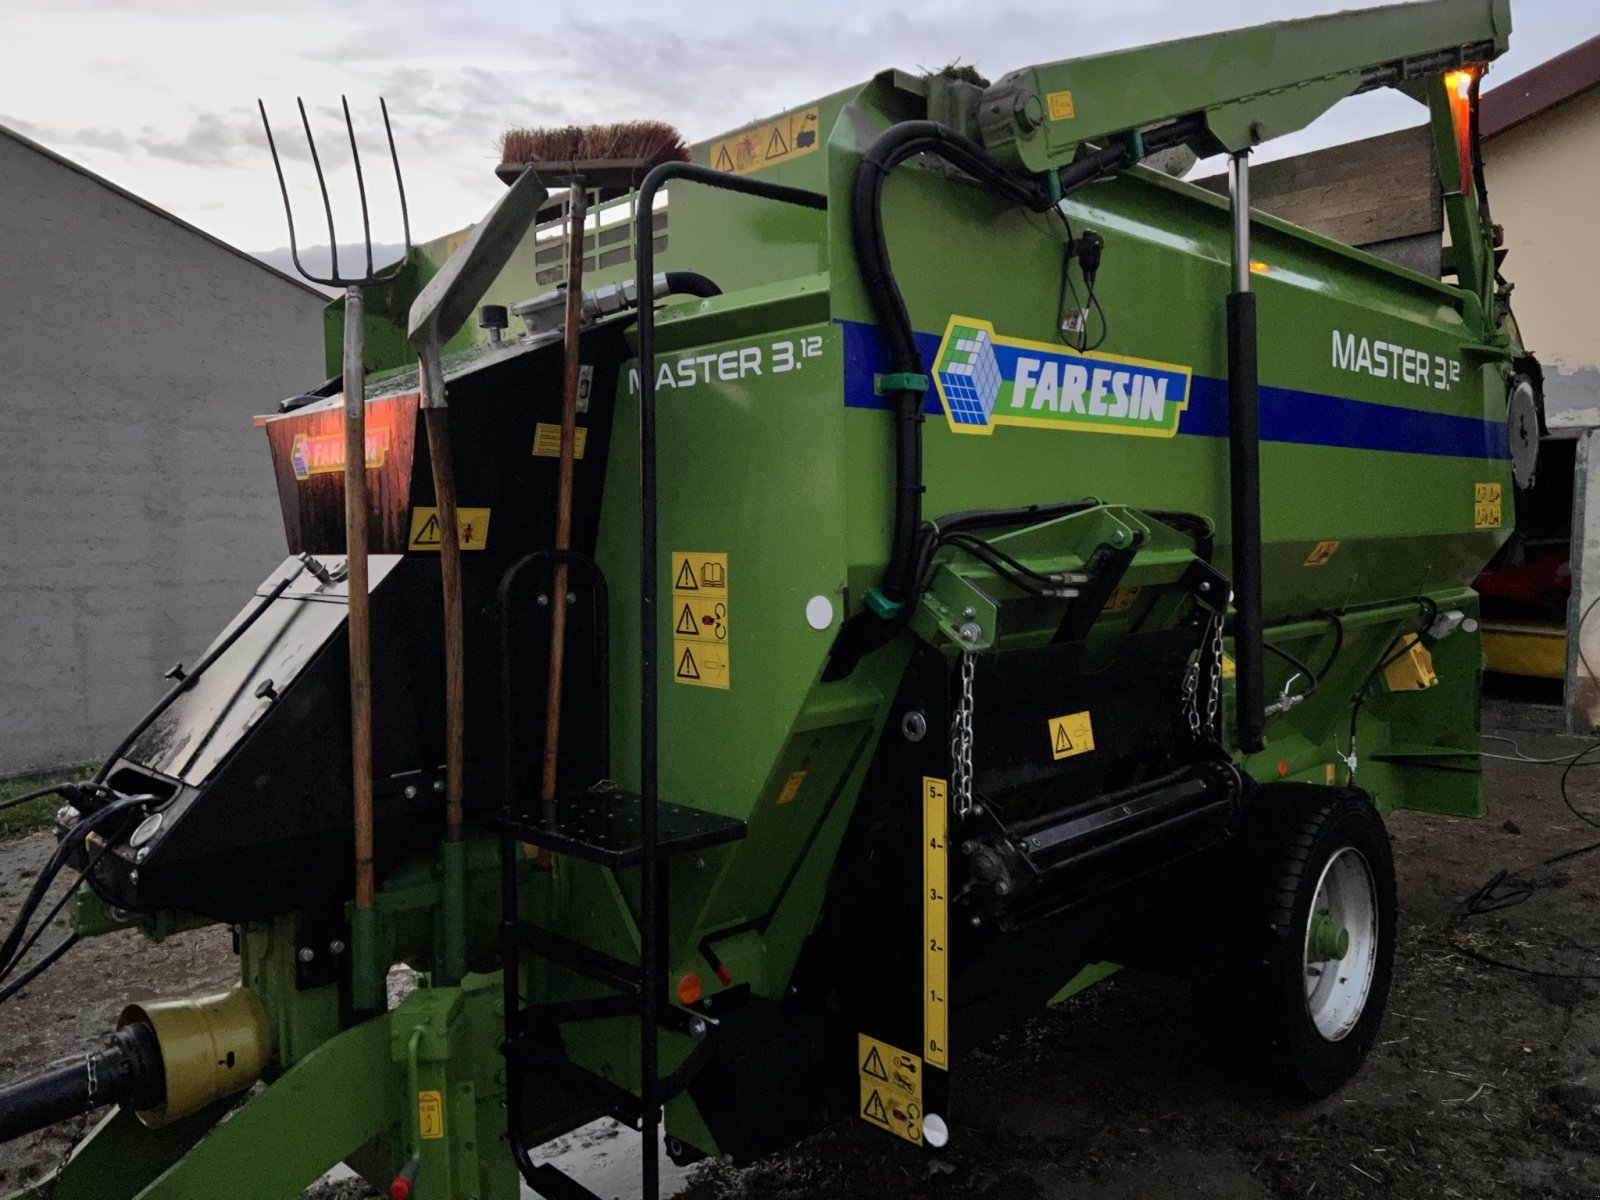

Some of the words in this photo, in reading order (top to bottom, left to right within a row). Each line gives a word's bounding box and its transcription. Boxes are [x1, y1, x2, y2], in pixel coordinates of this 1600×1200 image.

[1332, 329, 1429, 386] MASTER
[1010, 356, 1169, 422] FARESIN
[313, 436, 378, 467] FARN
